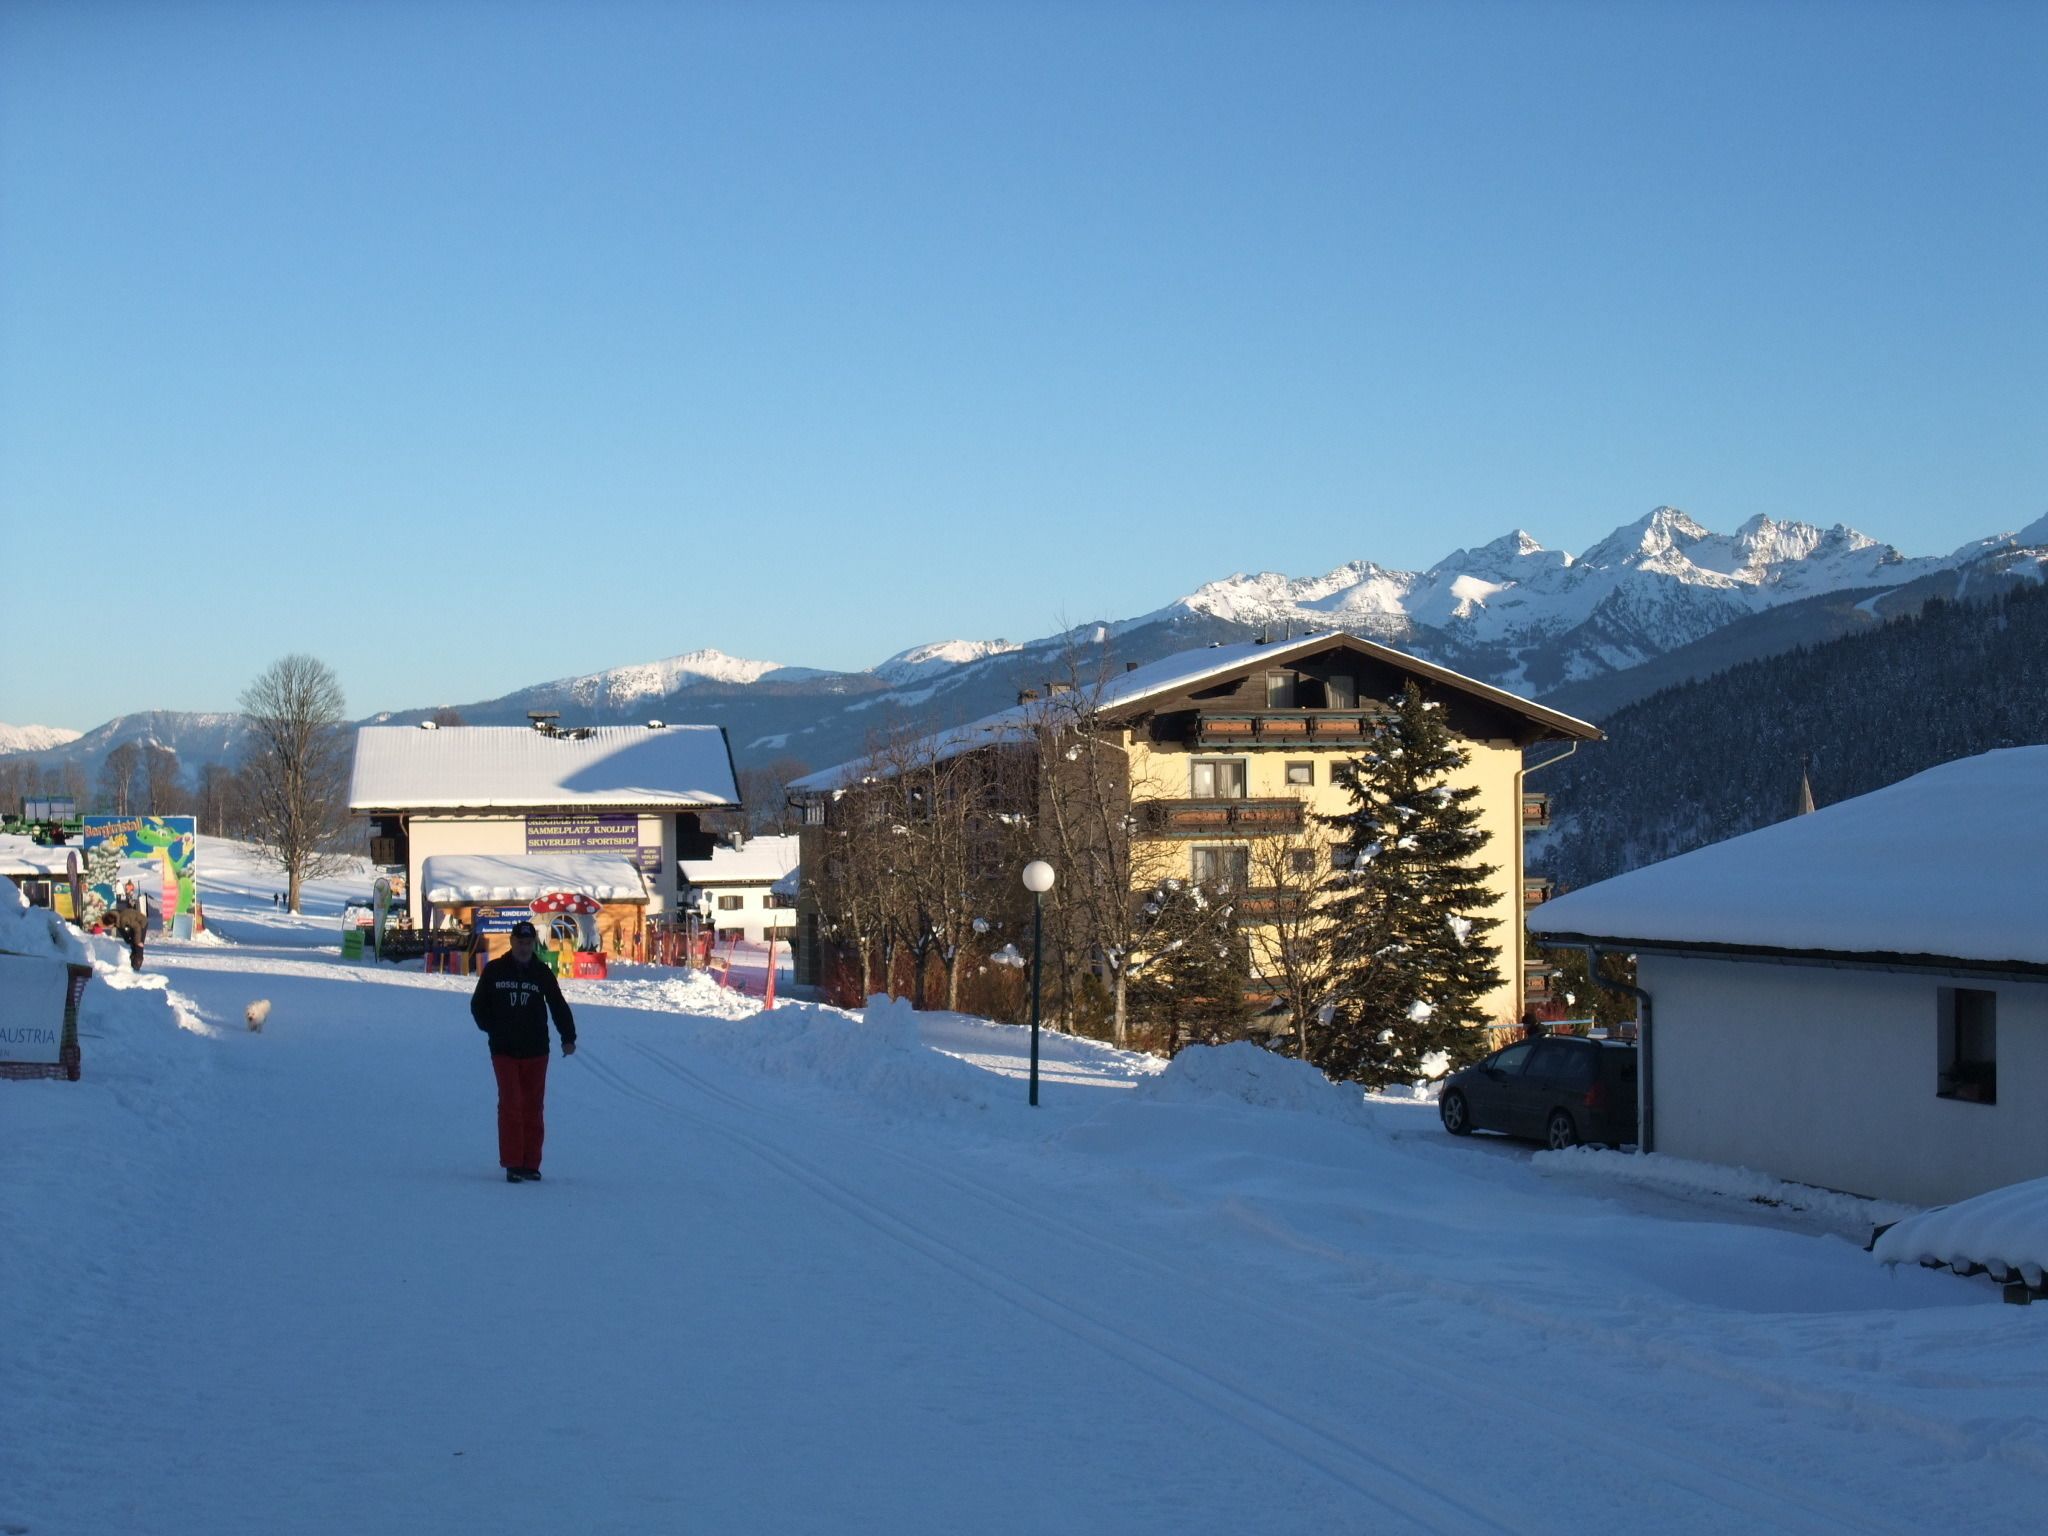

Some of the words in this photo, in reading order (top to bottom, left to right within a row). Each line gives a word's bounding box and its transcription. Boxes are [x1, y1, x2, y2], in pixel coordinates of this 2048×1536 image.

[528, 826, 590, 835] SAMMELPLATZ
[594, 825, 636, 833] KNOLLIFT
[528, 838, 580, 846] SKIVERLEIH
[0, 1027, 55, 1044] AUSTRIA
